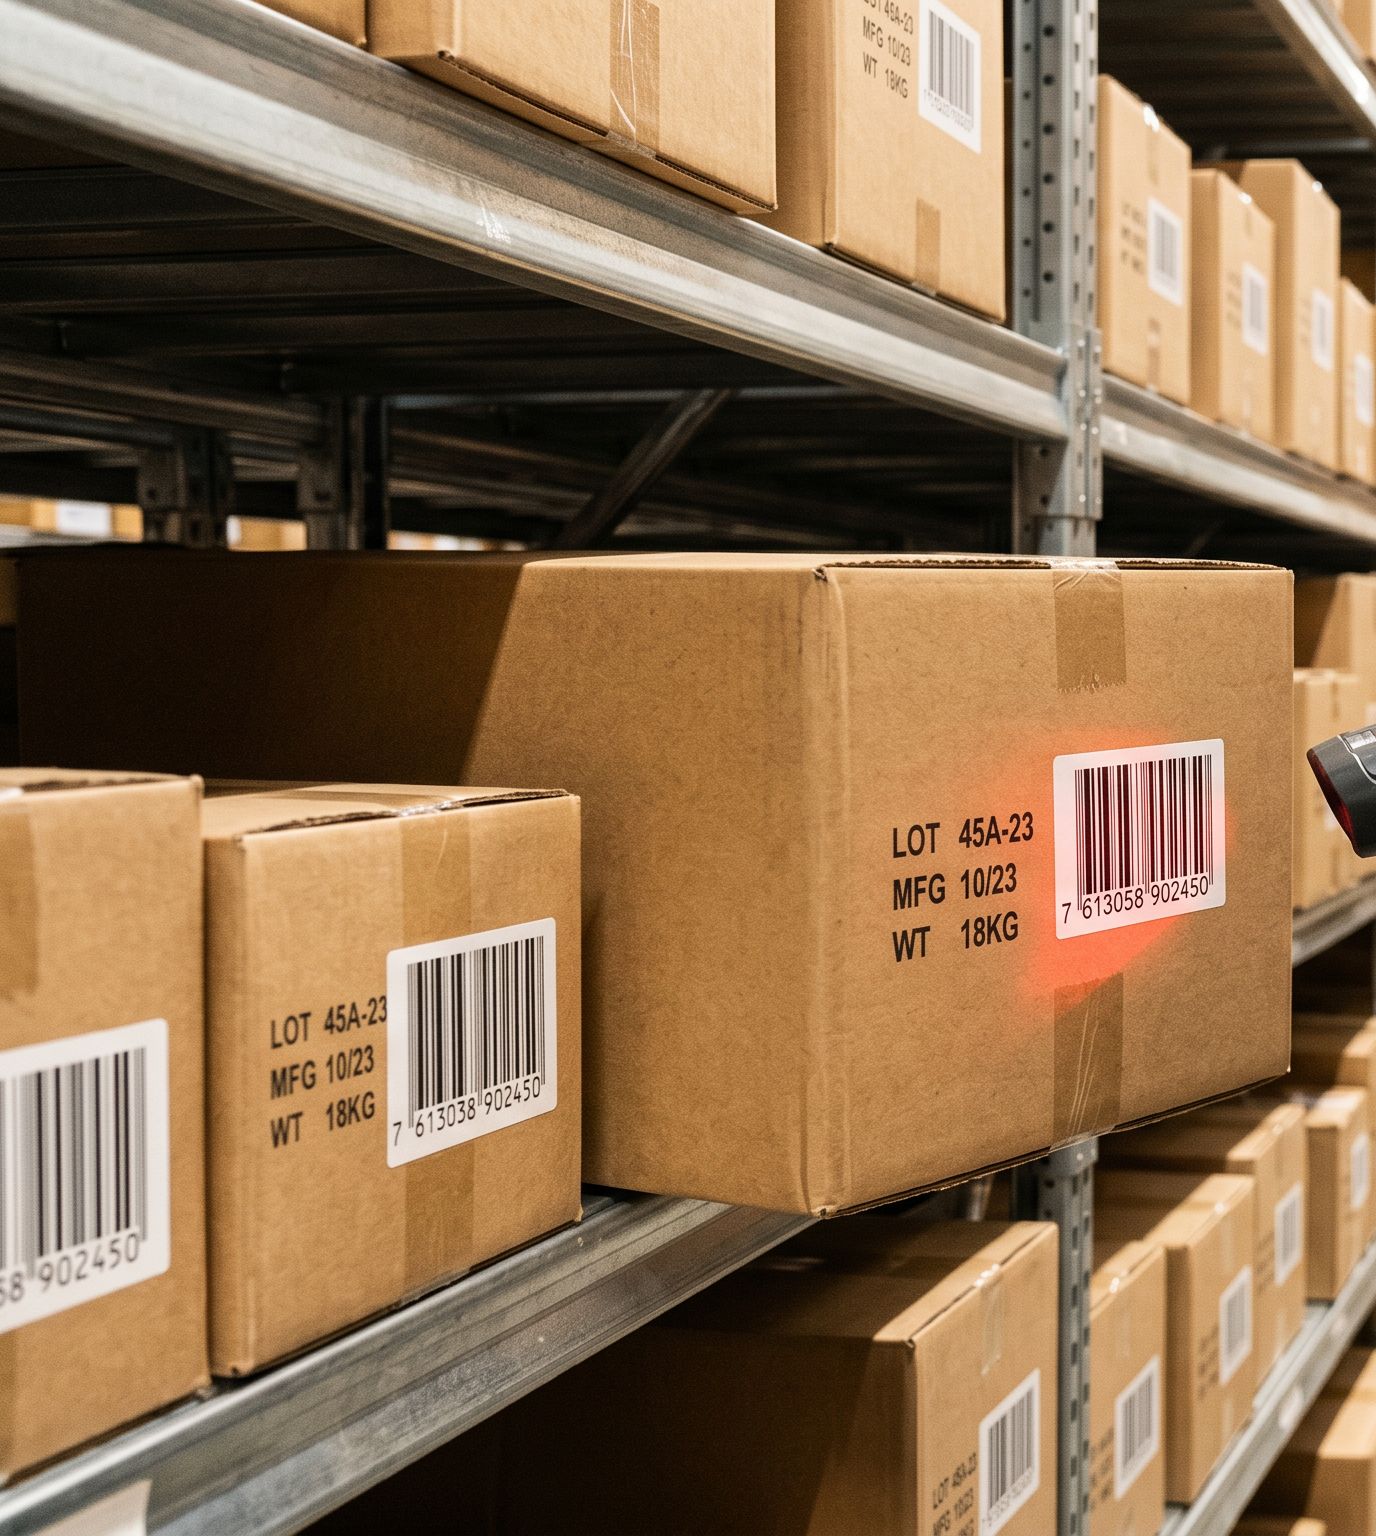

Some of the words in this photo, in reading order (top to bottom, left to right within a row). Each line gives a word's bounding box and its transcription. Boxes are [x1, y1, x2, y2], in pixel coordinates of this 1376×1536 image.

[862, 16, 884, 48] MFG
[862, 52, 878, 78] WT
[884, 68, 908, 99] 18KG
[892, 822, 941, 858] LOT
[958, 811, 1034, 848] 45A-23
[893, 873, 946, 911] MFG
[960, 862, 1017, 899] 10/23
[1061, 902, 1072, 924] 7
[1082, 887, 1144, 920] 613058
[1151, 875, 1209, 906] 902450
[892, 925, 931, 963] WT
[960, 911, 1019, 949] 18KG
[271, 1012, 311, 1049] LOT
[324, 995, 387, 1035] 45A-23
[271, 1059, 316, 1100] MFG
[326, 1045, 374, 1083] 10/23
[271, 1111, 303, 1148] WT
[326, 1091, 376, 1131] 18KG
[393, 1121, 402, 1146] 7
[415, 1097, 476, 1138] 613038
[484, 1076, 541, 1116] 902450
[39, 1232, 140, 1293] 902450
